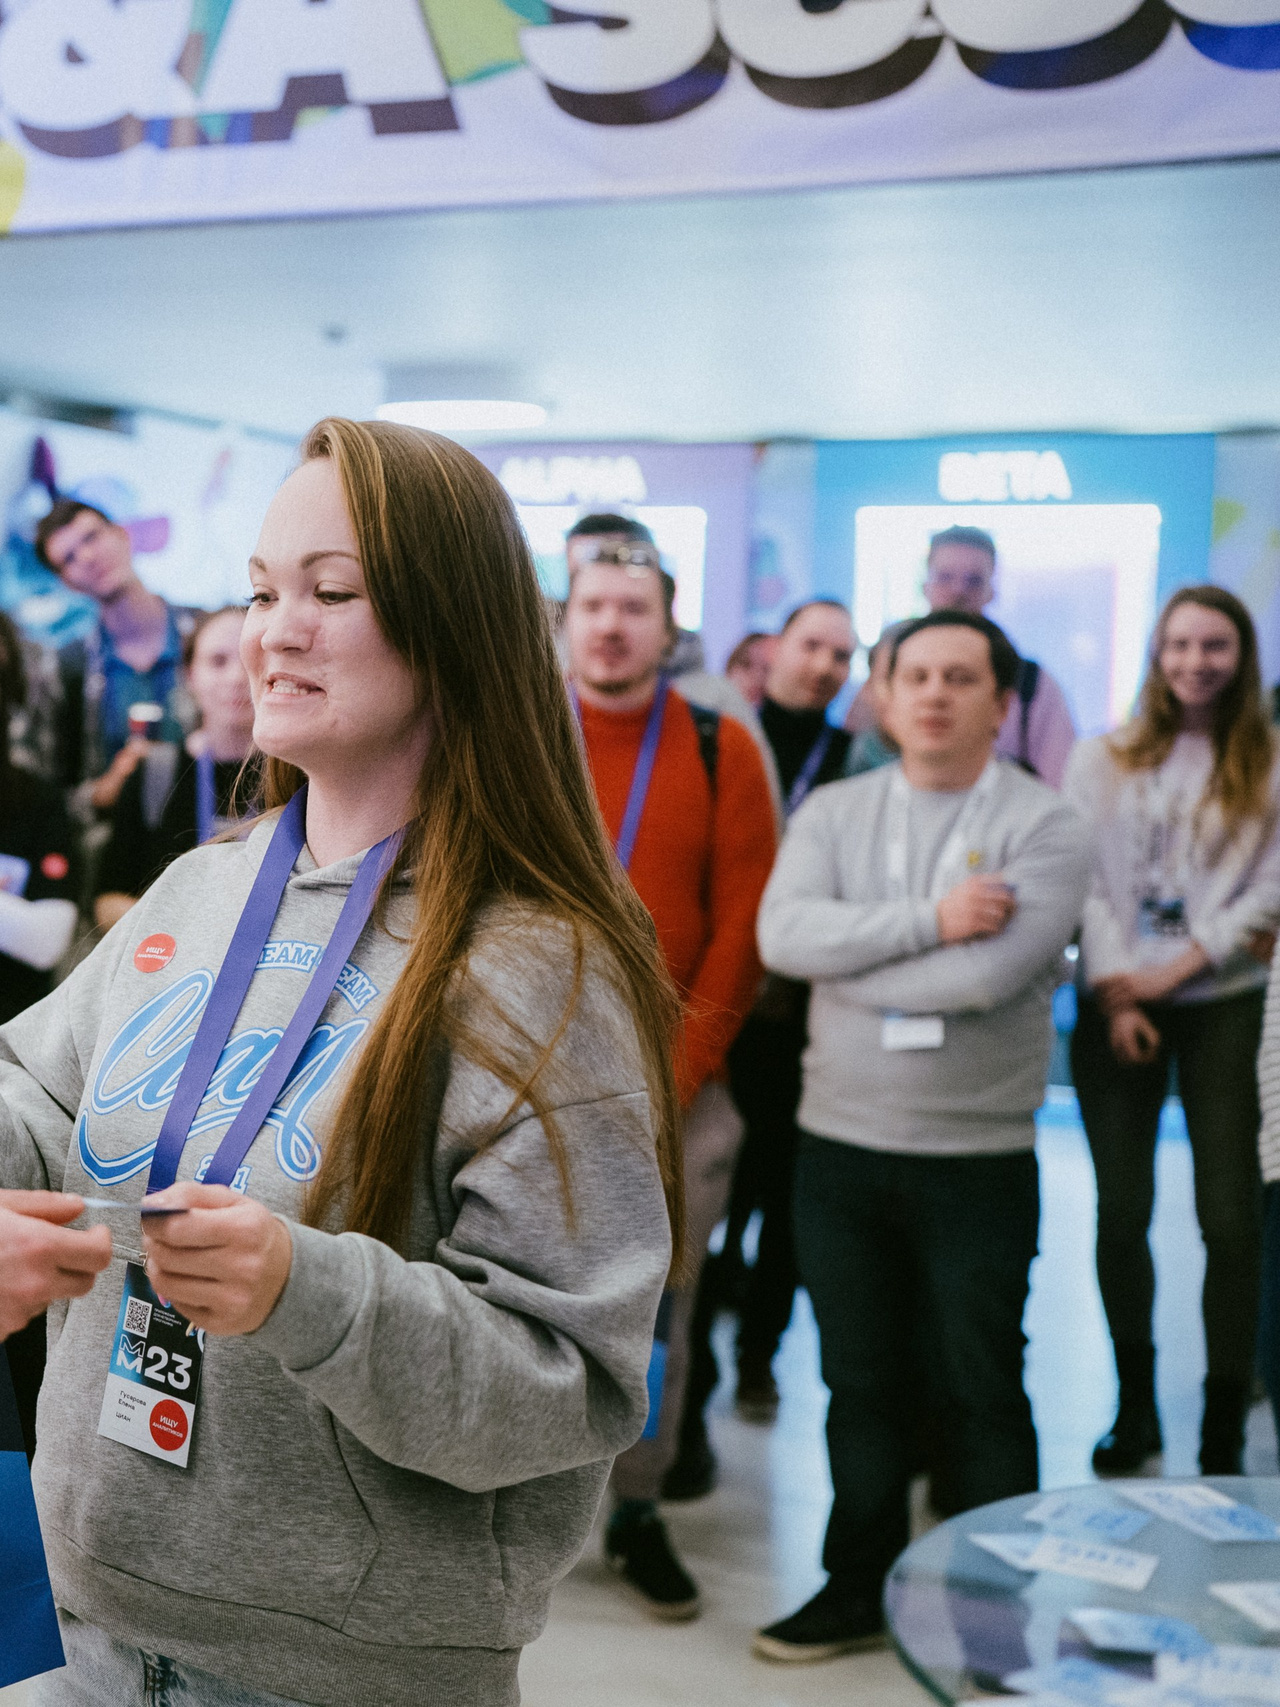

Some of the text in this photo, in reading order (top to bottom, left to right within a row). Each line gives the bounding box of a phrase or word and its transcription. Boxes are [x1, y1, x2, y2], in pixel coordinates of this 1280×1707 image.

[938, 450, 1073, 502] BETA
[118, 1398, 135, 1410] Елена
[119, 1390, 146, 1406] Гусарова
[159, 1415, 178, 1428] ИЩУ
